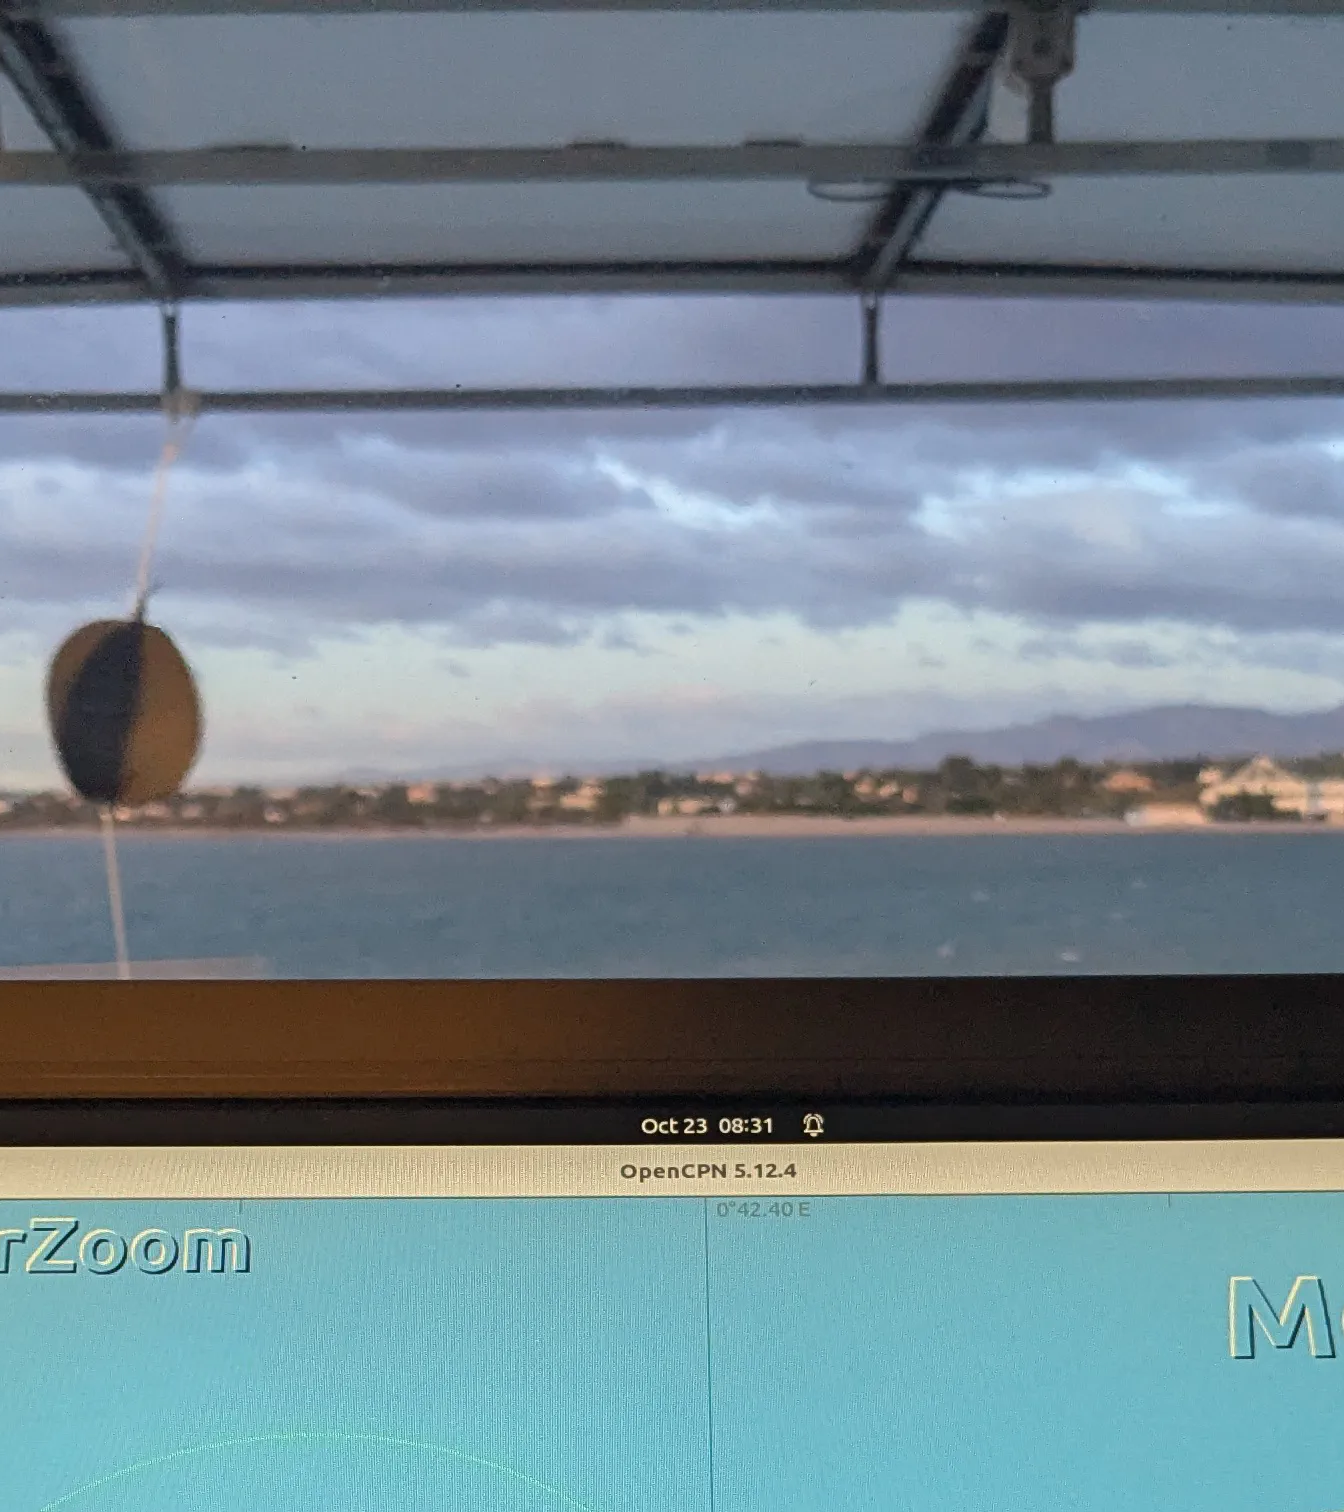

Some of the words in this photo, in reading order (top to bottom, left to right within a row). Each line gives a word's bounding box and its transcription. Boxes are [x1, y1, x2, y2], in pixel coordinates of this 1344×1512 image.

[640, 1116, 678, 1135] Oct
[682, 1117, 708, 1135] 23
[718, 1117, 774, 1135] 08:31
[620, 1162, 727, 1183] OpenCPN
[734, 1161, 797, 1181] 5.12.4
[716, 1201, 793, 1219] 0°42.40
[798, 1201, 812, 1218] E
